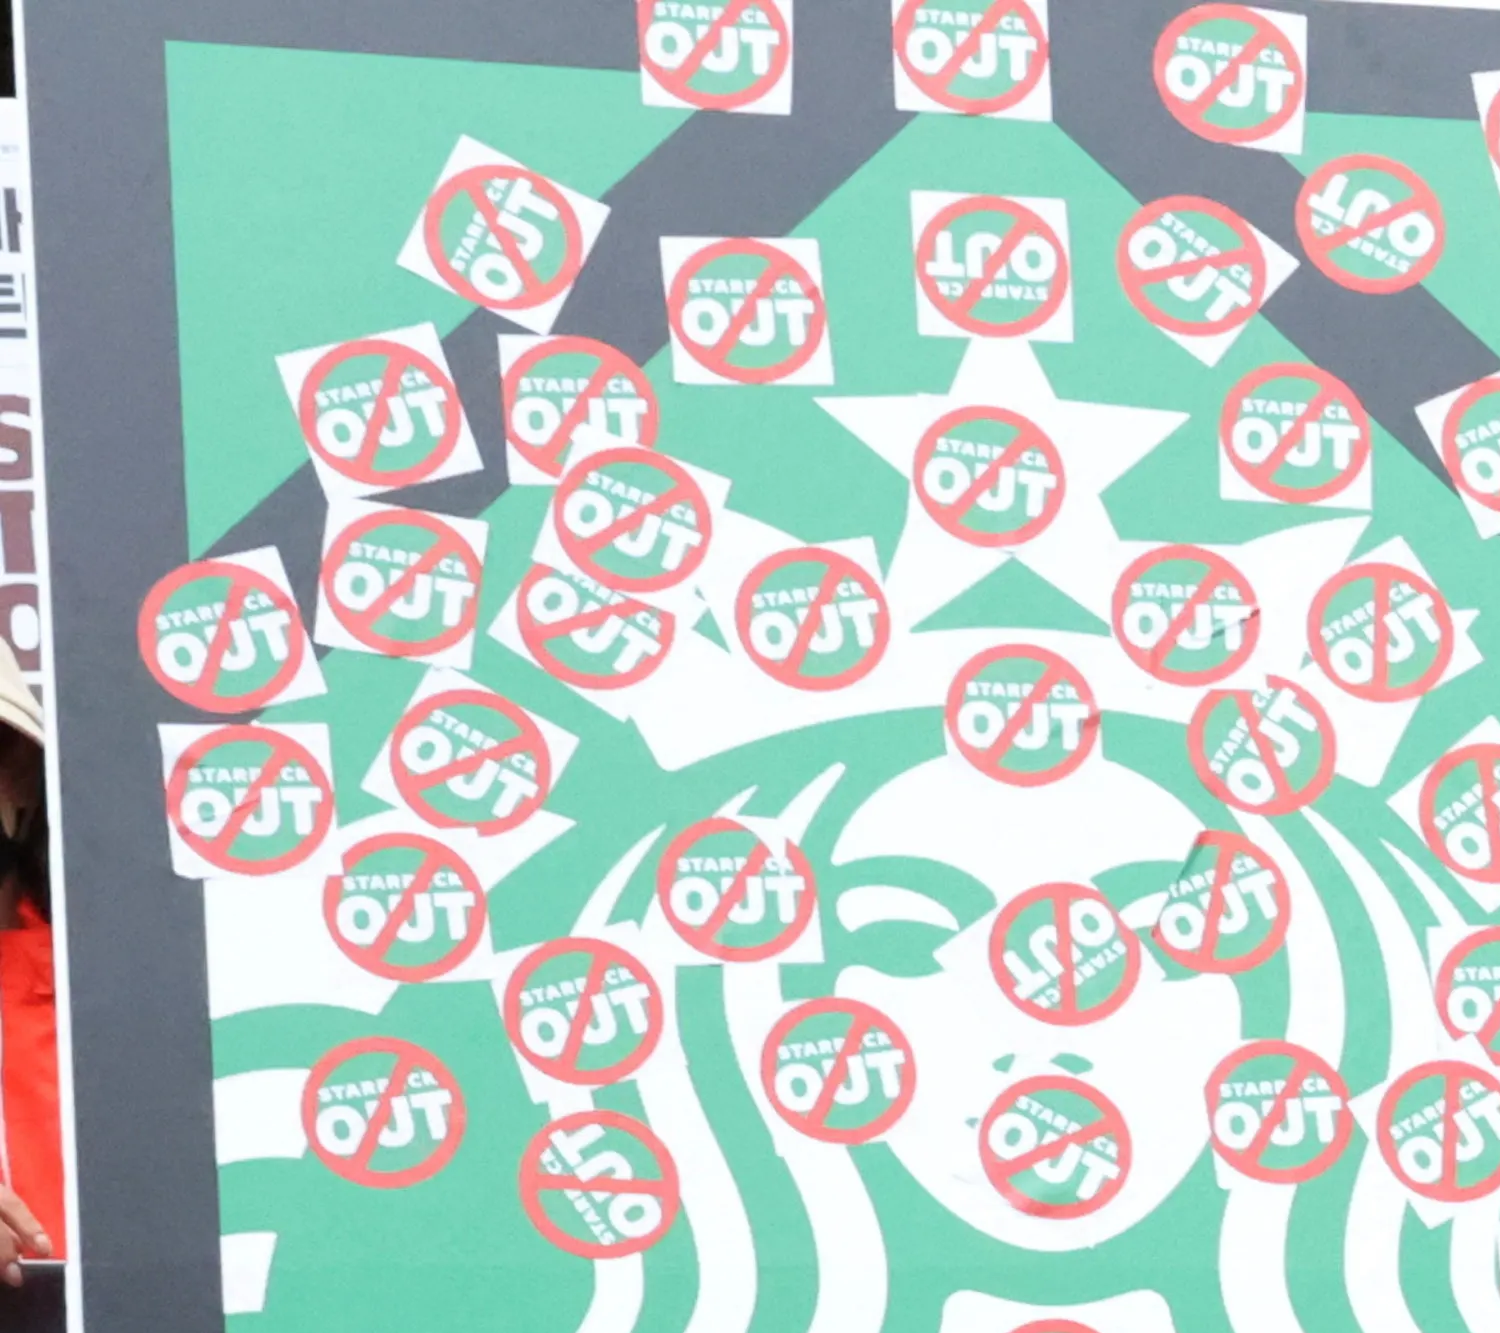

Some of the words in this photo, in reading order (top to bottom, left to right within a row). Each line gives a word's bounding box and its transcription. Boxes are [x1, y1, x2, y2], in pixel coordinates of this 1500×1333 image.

[645, 21, 781, 77] OUT
[905, 28, 1038, 82] OUT
[1164, 55, 1296, 115] OUT
[472, 176, 561, 301] OUT
[1306, 170, 1435, 255] OUT
[925, 229, 1057, 280] OUT
[1128, 227, 1252, 325] OUT
[681, 298, 816, 347] OUT
[317, 386, 448, 458] OUT
[1231, 417, 1362, 471] OUT
[923, 457, 1057, 519] OUT
[562, 491, 703, 573] OUT
[334, 562, 475, 629] OUT
[526, 577, 663, 674] OUT
[750, 598, 880, 660] OUT
[1122, 602, 1252, 652] OUT
[156, 609, 293, 683] OUT
[1331, 592, 1444, 685] OUT
[957, 701, 1090, 752] OUT
[1228, 687, 1321, 805] OUT
[399, 727, 539, 821] OUT
[180, 786, 324, 839] OUT
[336, 891, 476, 946] OUT
[670, 876, 806, 926] OUT
[1159, 869, 1279, 951] OUT
[999, 898, 1113, 1000] OUT
[521, 982, 652, 1058] OUT
[775, 1049, 907, 1113] OUT
[316, 1088, 454, 1156] OUT
[1215, 1096, 1343, 1150] OUT
[548, 1120, 662, 1236] OUT
[988, 1114, 1121, 1203] OUT
